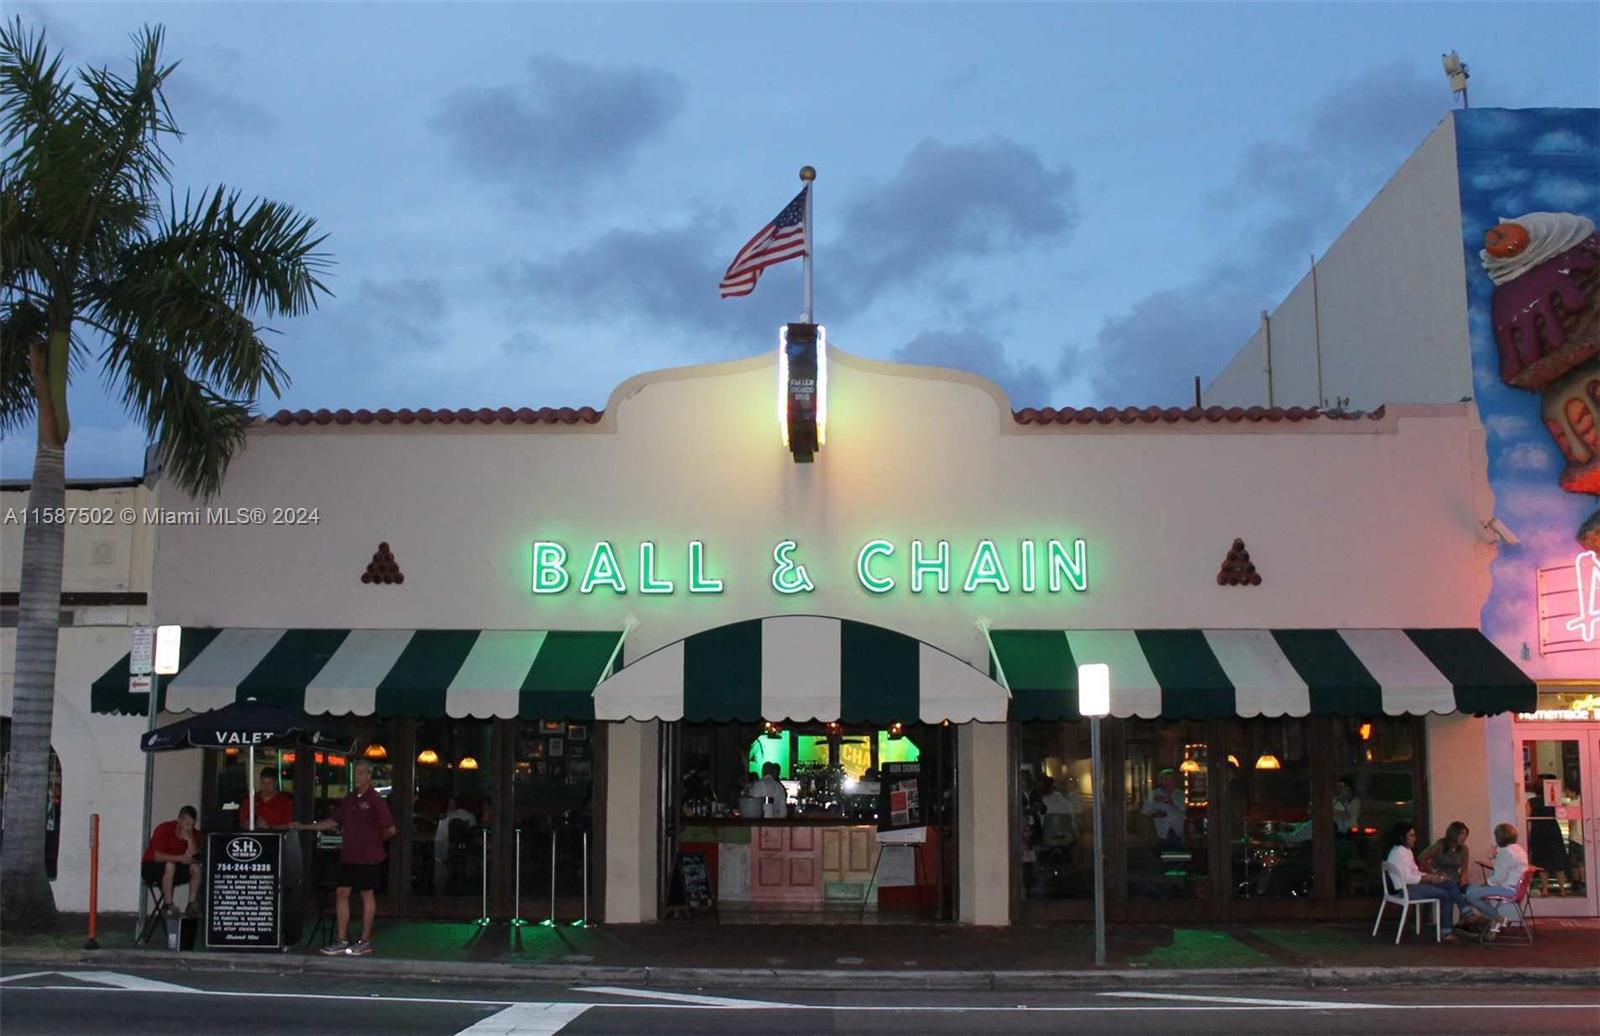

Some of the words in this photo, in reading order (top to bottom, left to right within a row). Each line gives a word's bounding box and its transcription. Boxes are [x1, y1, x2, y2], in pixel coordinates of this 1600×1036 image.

[532, 541, 724, 593] BALL
[771, 540, 815, 594] &
[857, 540, 1088, 593] CHAIN
[216, 731, 274, 744] VALET
[232, 840, 257, 853] S.H.
